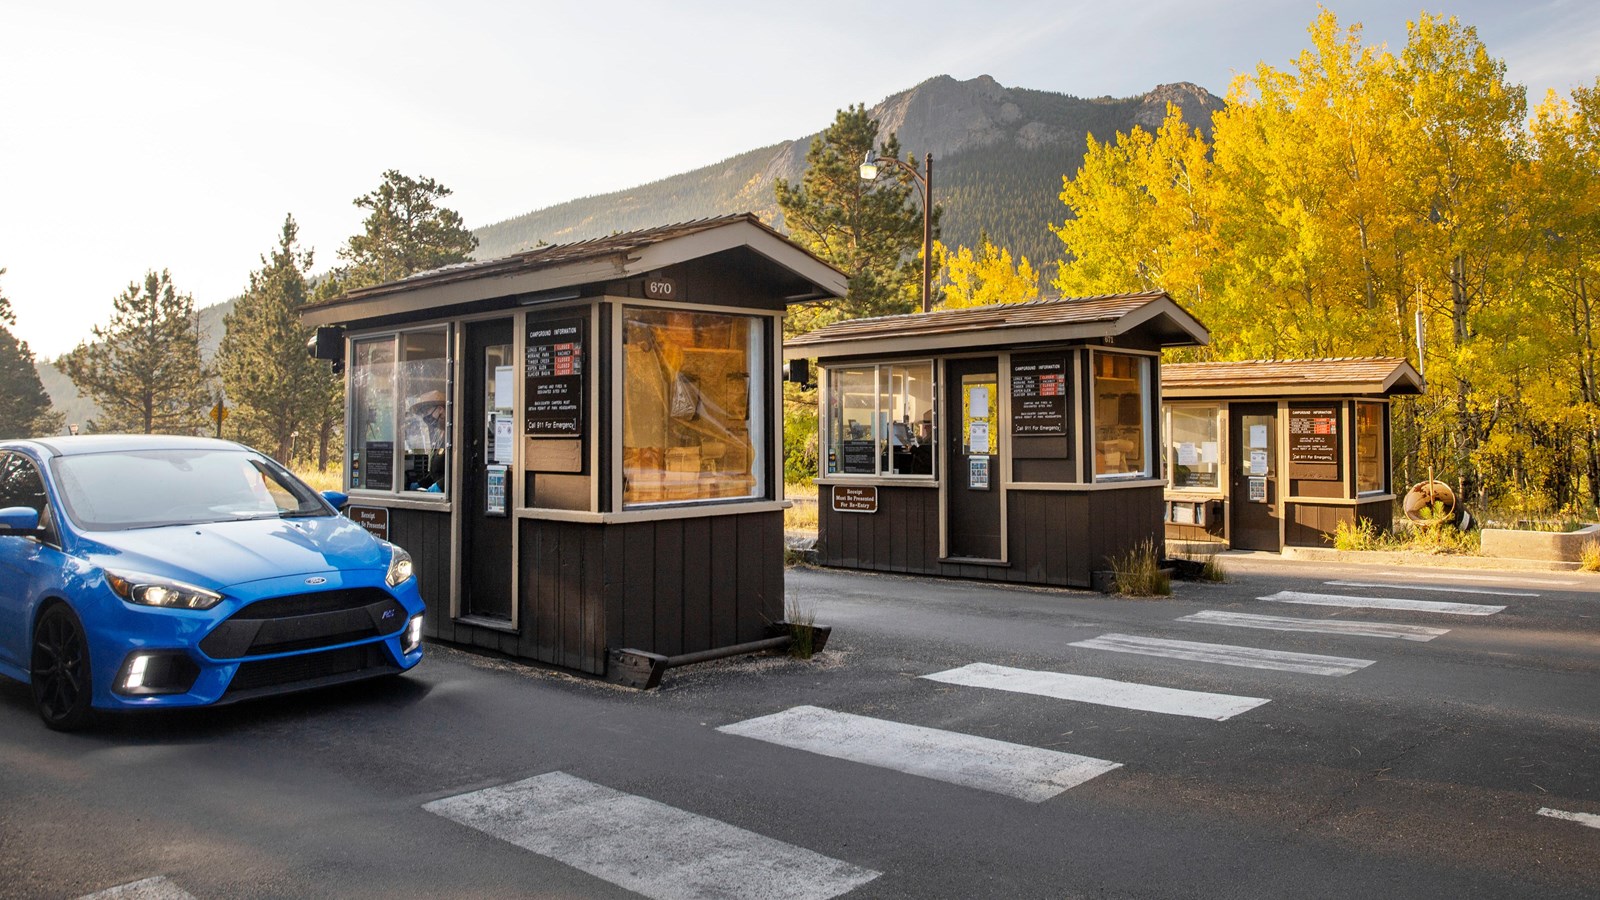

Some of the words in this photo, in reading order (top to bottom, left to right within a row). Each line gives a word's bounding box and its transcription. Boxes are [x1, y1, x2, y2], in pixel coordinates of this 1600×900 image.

[650, 282, 671, 294] 670
[530, 330, 551, 338] CAMPGROUND
[554, 327, 576, 335] INFORMATION
[553, 421, 574, 430] Emergency
[361, 512, 375, 520] Receipt
